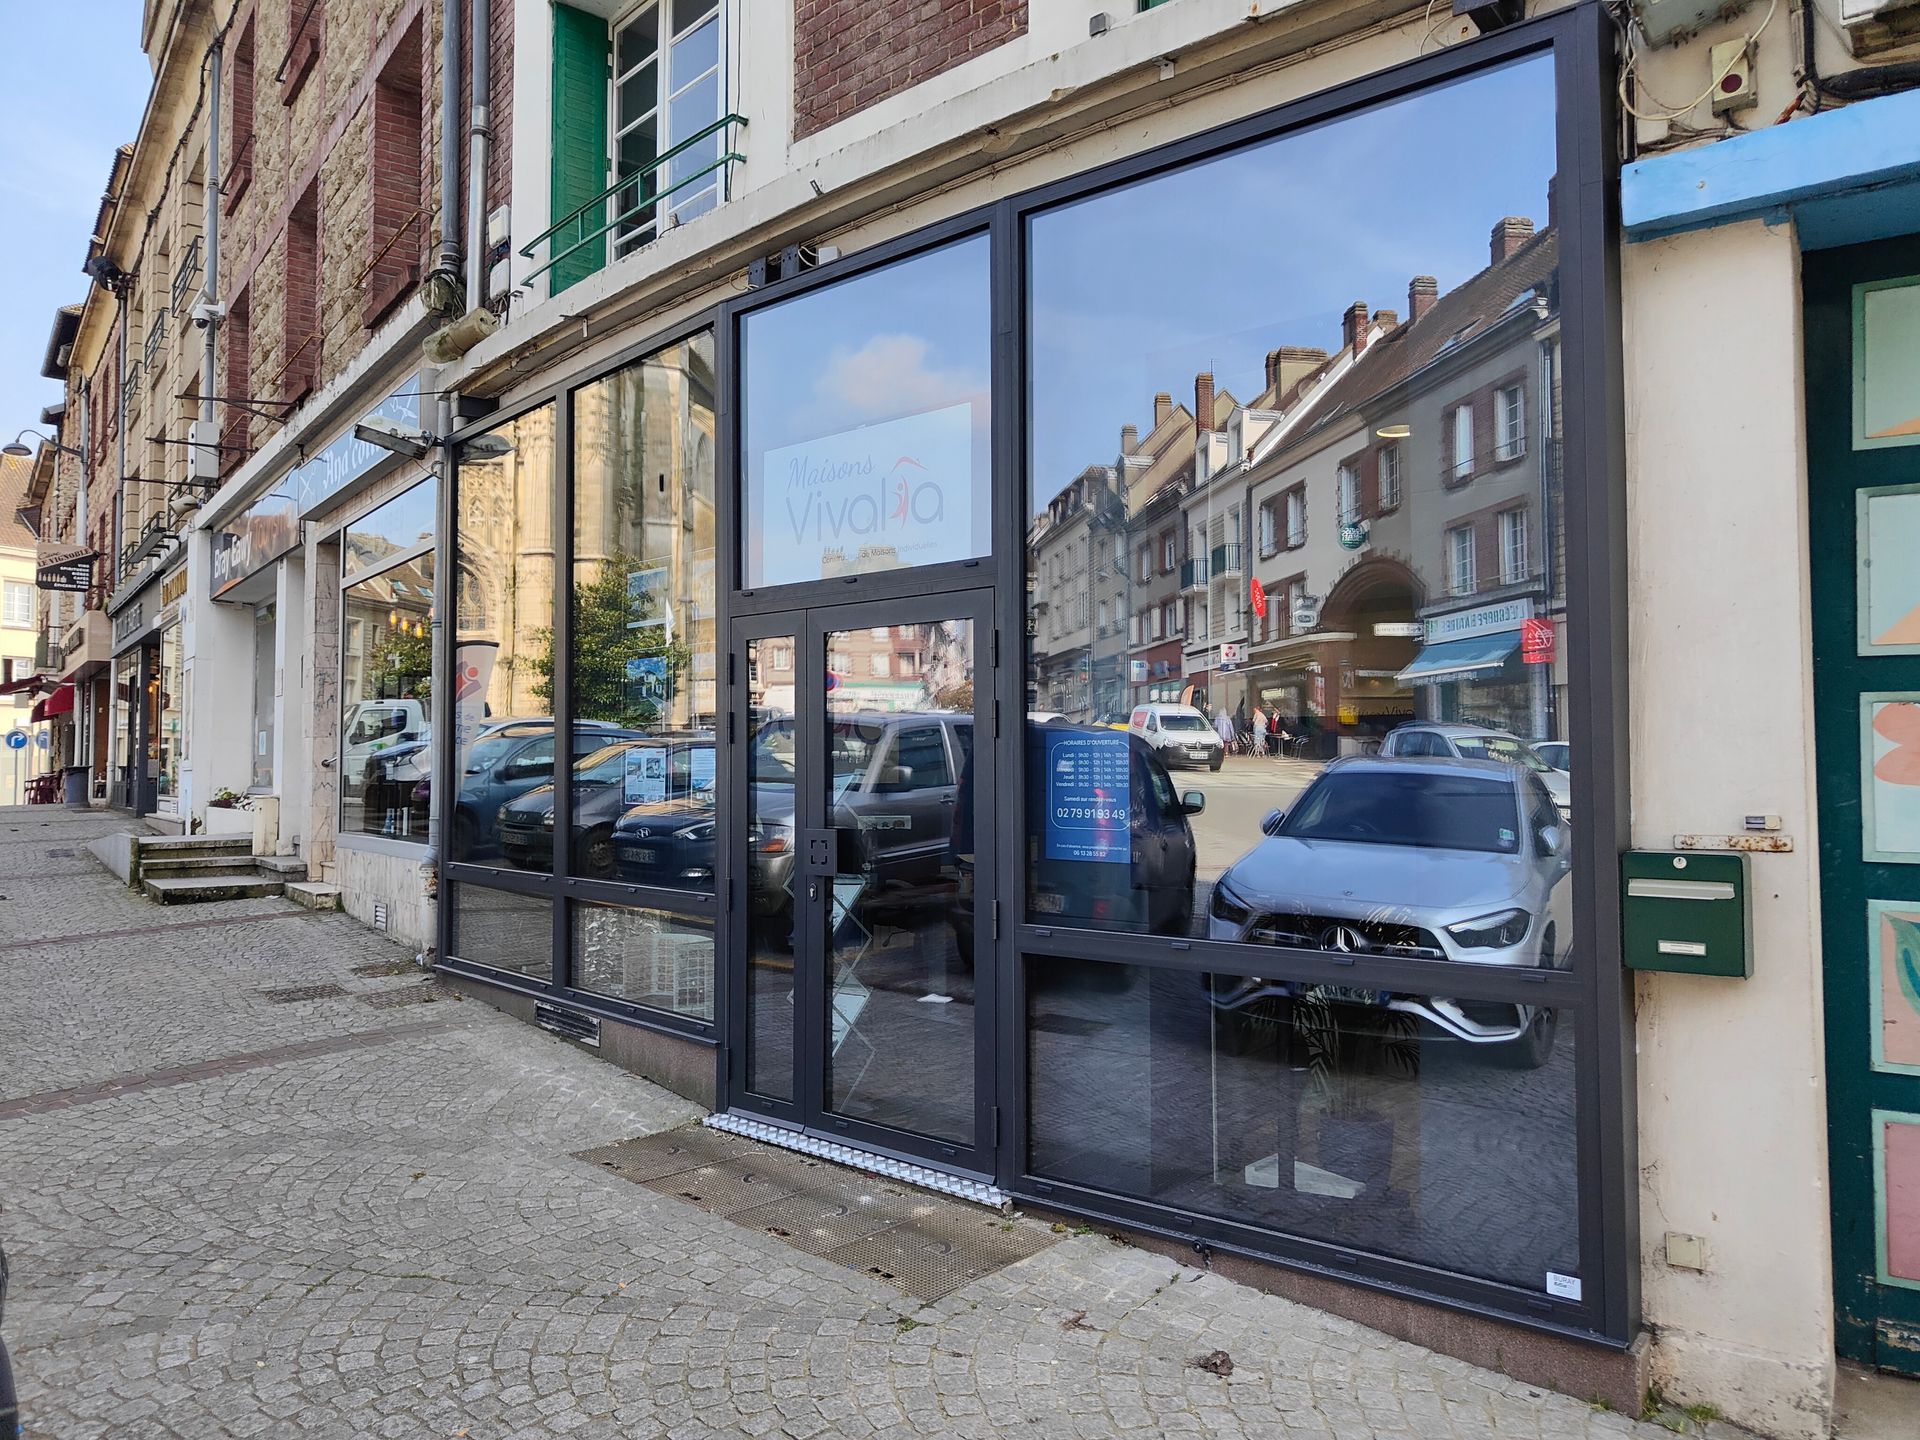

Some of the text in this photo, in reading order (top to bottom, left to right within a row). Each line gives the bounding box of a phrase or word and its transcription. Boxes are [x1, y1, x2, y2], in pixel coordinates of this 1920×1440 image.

[786, 455, 878, 493] Maisons
[785, 475, 944, 545] Vivalia
[48, 548, 91, 564] VIGNOBLE
[214, 547, 231, 581] Bray
[231, 531, 253, 568] Eawy
[1056, 807, 1126, 820] 02 79 91 93 49
